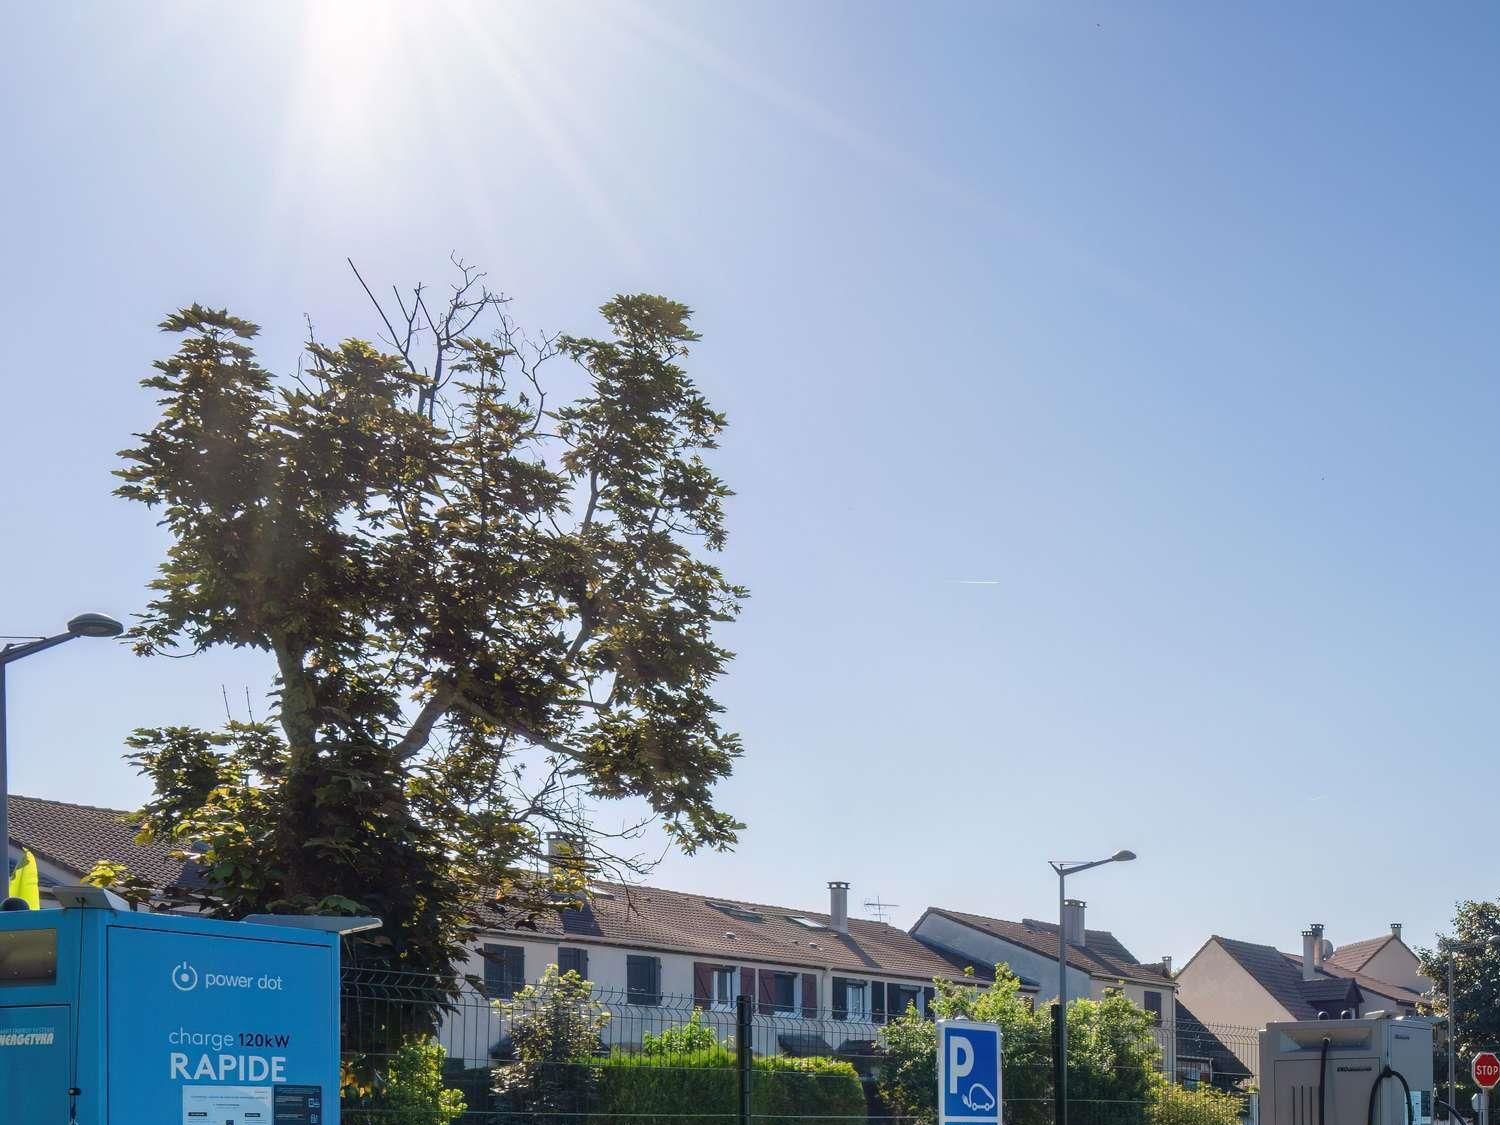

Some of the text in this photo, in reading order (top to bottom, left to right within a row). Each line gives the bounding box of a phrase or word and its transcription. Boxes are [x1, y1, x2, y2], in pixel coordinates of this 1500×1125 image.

[205, 973, 283, 991] power dot
[169, 1026, 234, 1051] charge
[170, 1052, 287, 1082] RAPIDE
[950, 1036, 975, 1094] P
[1476, 1065, 1498, 1076] STOP
